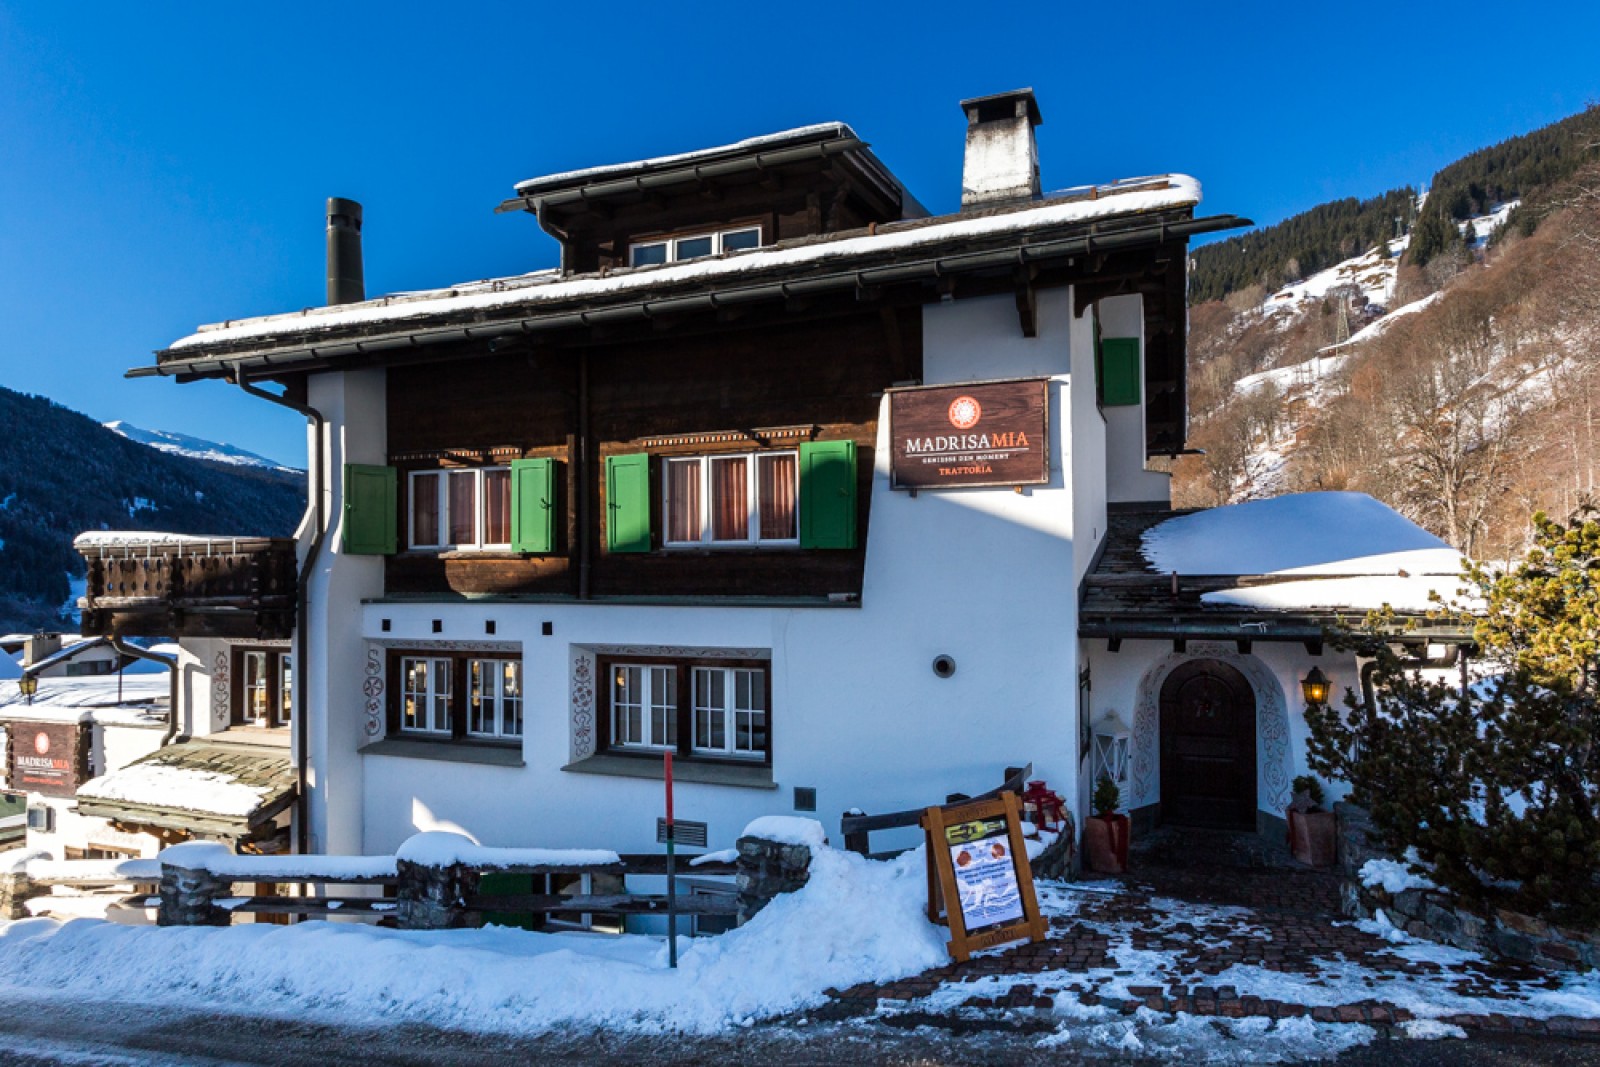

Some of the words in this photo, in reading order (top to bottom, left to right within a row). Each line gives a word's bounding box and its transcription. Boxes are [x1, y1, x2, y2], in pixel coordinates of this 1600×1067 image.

[906, 431, 1029, 453] MADRISAMIA
[976, 453, 1009, 462] MOMENT
[939, 465, 993, 475] TRATTORIA
